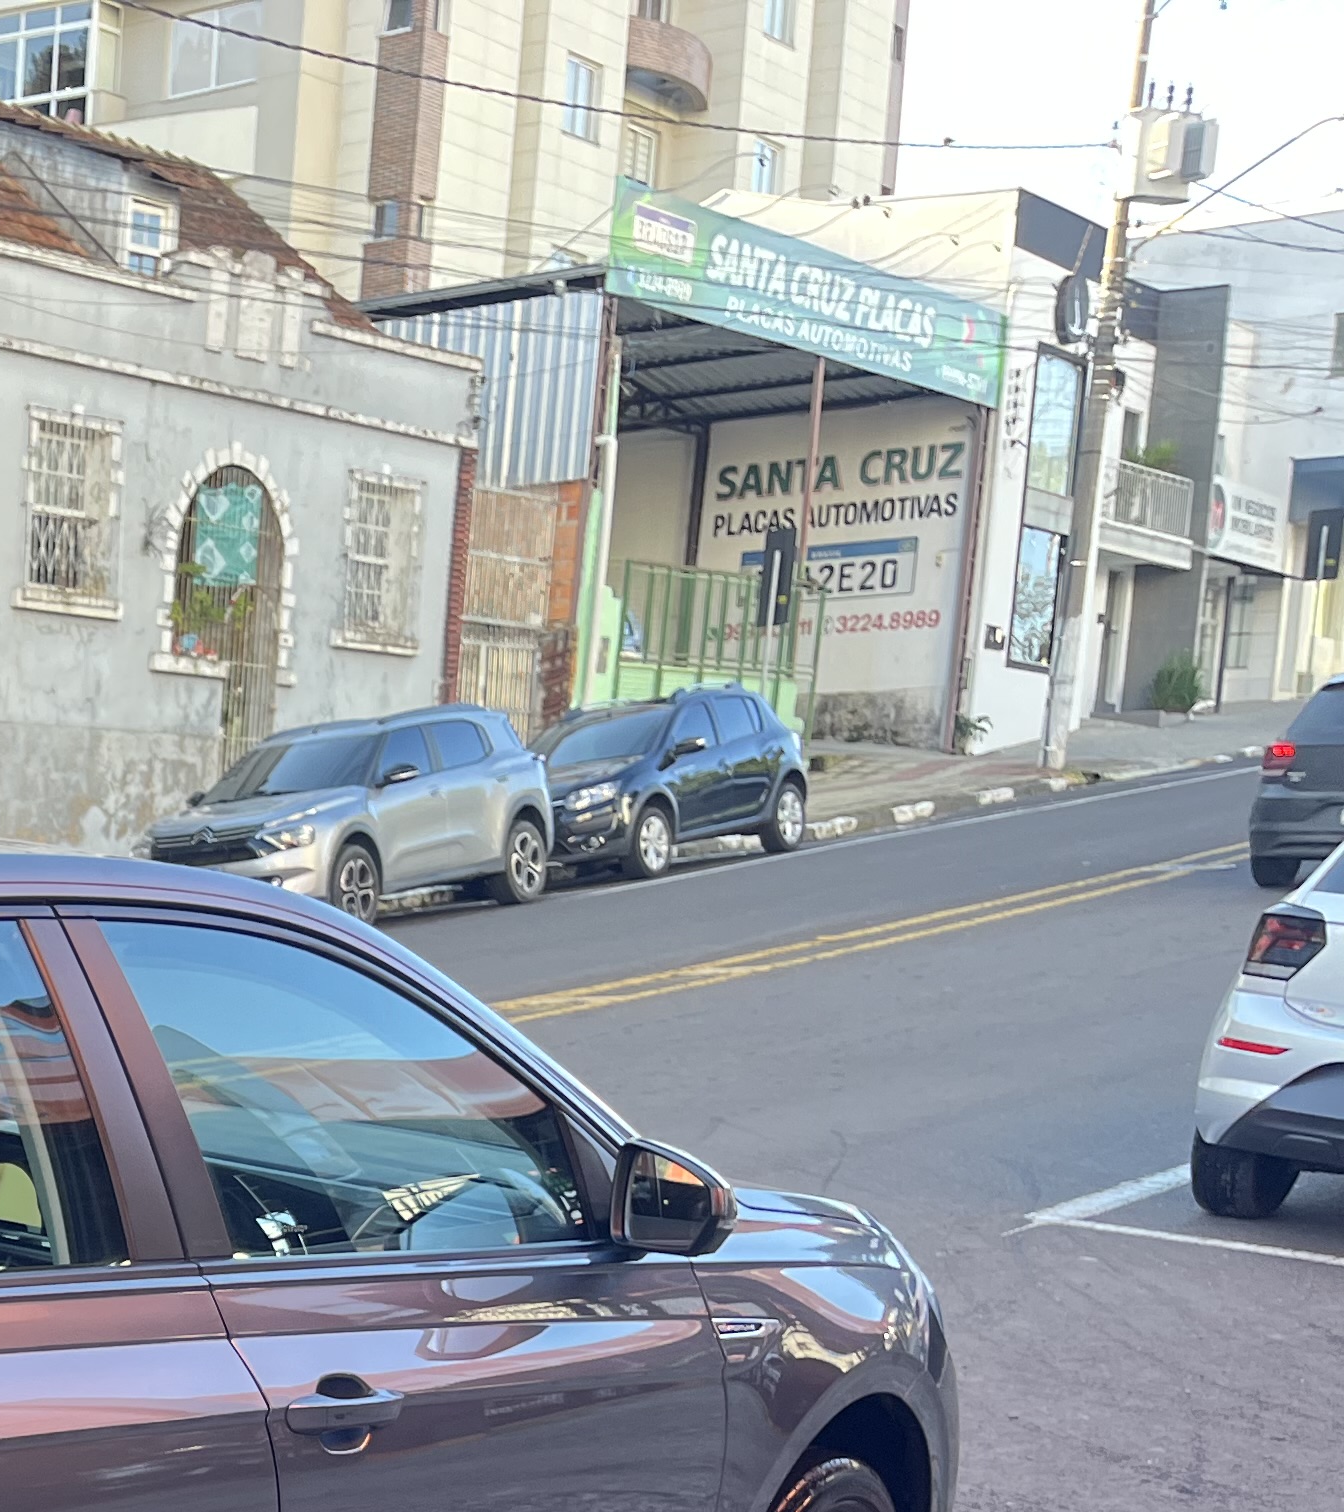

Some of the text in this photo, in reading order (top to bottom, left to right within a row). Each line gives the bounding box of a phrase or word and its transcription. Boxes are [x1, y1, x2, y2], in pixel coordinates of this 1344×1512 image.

[707, 233, 786, 300] SANTA
[789, 263, 855, 321] CRUZ
[855, 284, 937, 349] PLACAS
[724, 296, 912, 373] PLACAS AUTOMOTIVAS
[716, 442, 966, 500] SANTA CRUZ
[714, 508, 796, 537] PLACAS
[835, 609, 942, 634] 3224.8989
